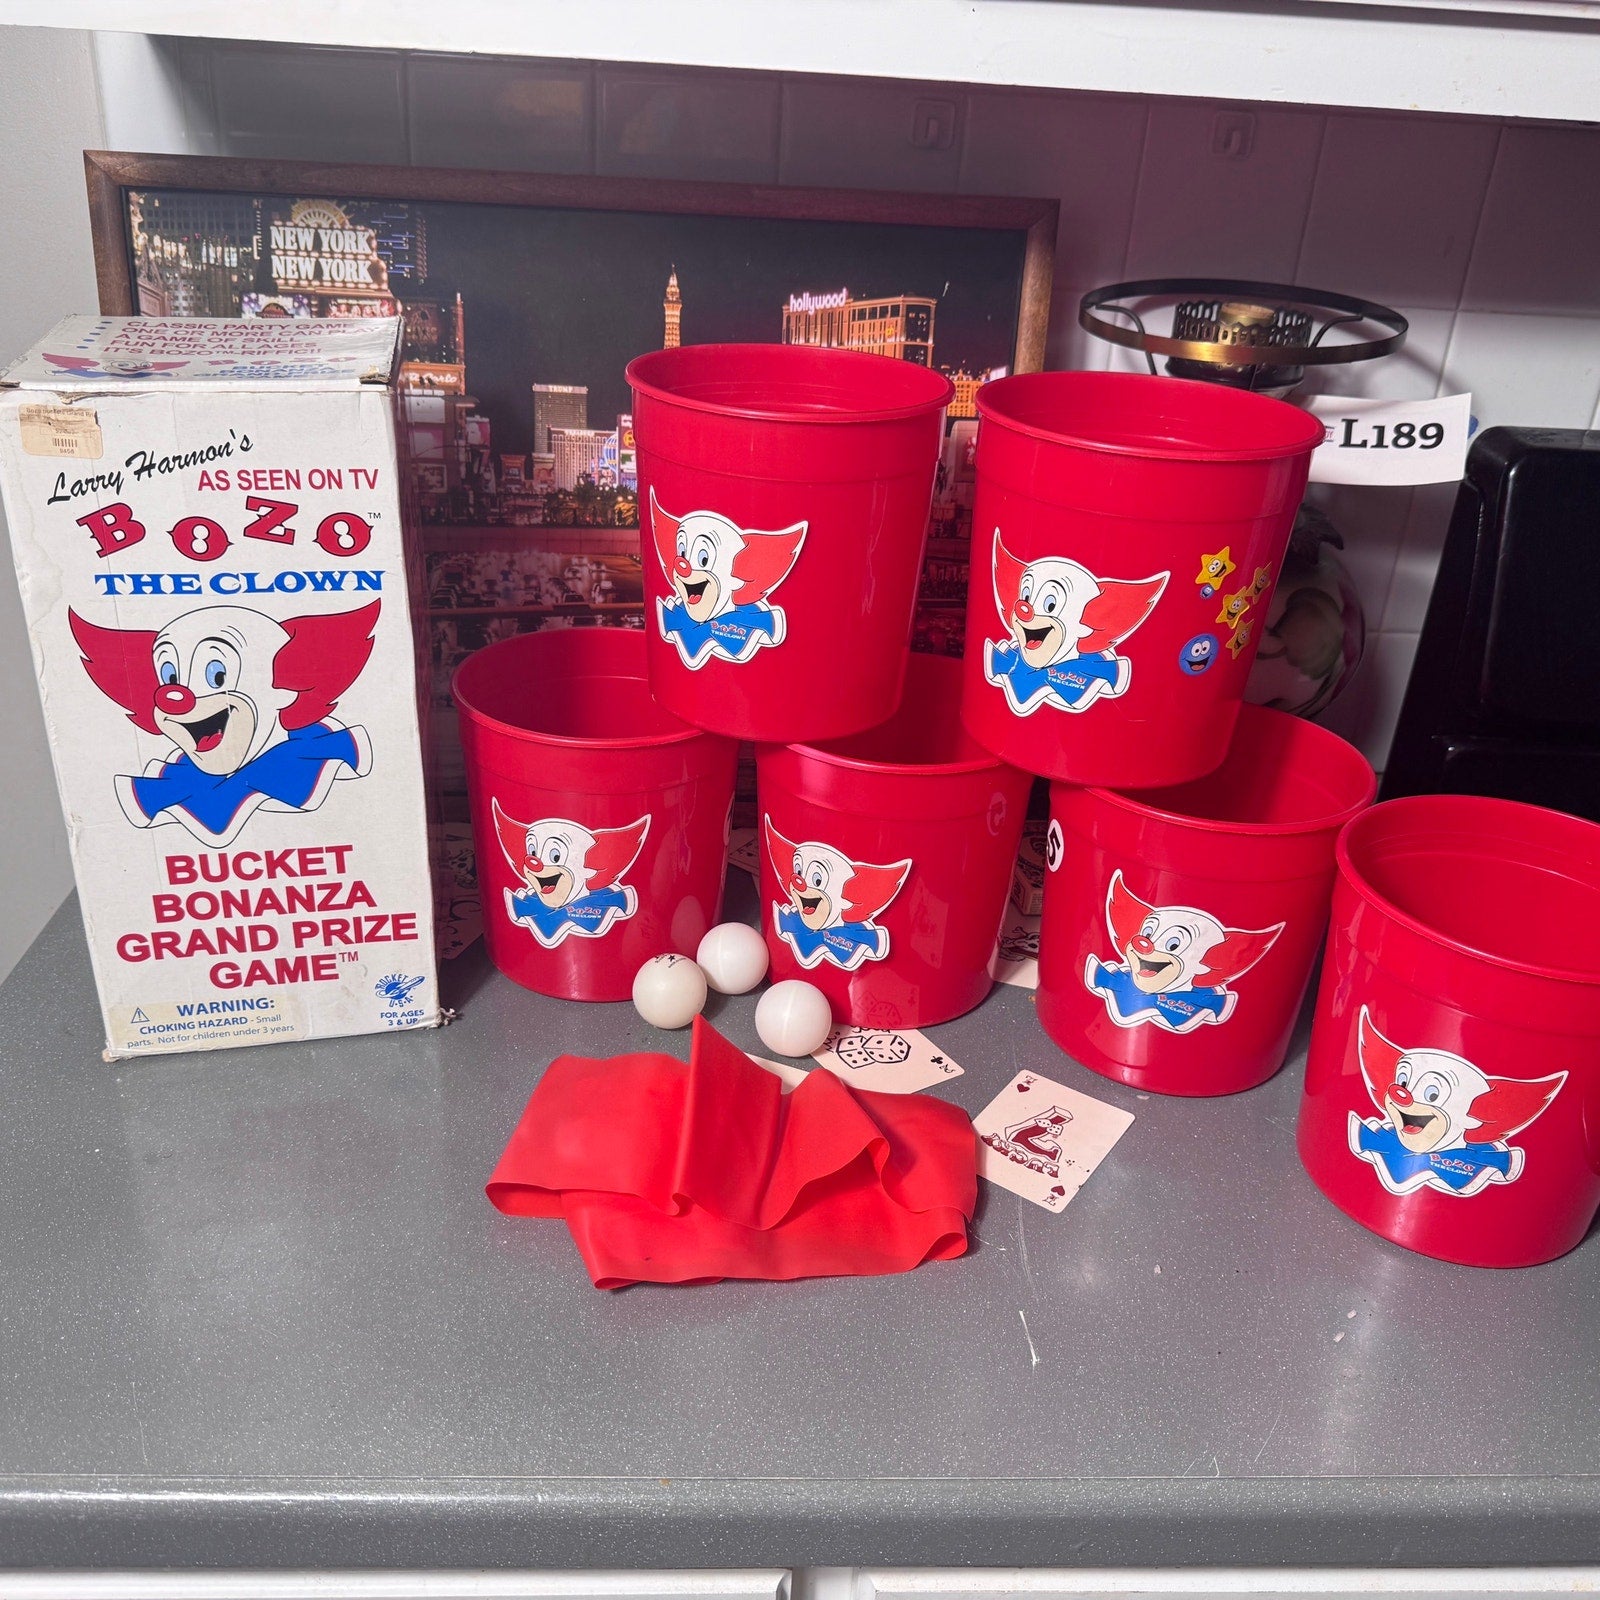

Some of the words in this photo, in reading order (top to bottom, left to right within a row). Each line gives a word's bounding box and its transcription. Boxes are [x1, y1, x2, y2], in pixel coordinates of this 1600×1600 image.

[270, 226, 315, 251] NEW
[318, 228, 372, 254] YORK
[271, 255, 316, 280] NEW
[319, 257, 373, 283] YORK
[790, 286, 848, 315] hollywood
[121, 327, 169, 335] ONE
[127, 321, 218, 330] CLASSIC
[223, 323, 291, 331] PARTY
[103, 346, 143, 354] IT'S
[110, 339, 156, 347] FUN
[1339, 418, 1444, 449] L189
[47, 471, 124, 505] Larry
[125, 429, 253, 482] Harmon's
[198, 469, 231, 491] AS
[237, 469, 301, 491] SEEN
[308, 468, 343, 490] ON
[348, 469, 379, 490] TV
[94, 573, 203, 595] THE
[209, 570, 386, 594] CLOWN
[710, 620, 747, 636] BOZO
[1047, 668, 1087, 685] BOZO
[1048, 827, 1061, 866] 5
[165, 845, 353, 886] BUCKET
[152, 880, 377, 924] BONANZA
[116, 923, 280, 963] GRAND
[292, 912, 418, 949] PRIZE
[375, 973, 408, 990] ROCKET
[176, 997, 276, 1017] WARNING:
[380, 1011, 399, 1019] FOR
[400, 1009, 425, 1018] AGES
[139, 1021, 196, 1035] CHOKING
[198, 1016, 248, 1029] HAZARD
[256, 1014, 282, 1024] Small
[406, 1017, 418, 1025] UP
[127, 1039, 154, 1049] parts.
[157, 1036, 176, 1044] Not
[177, 1034, 191, 1042] for
[192, 1030, 231, 1041] children
[233, 1028, 260, 1037] under
[262, 1026, 269, 1034] 3
[270, 1025, 295, 1036] years
[1429, 1153, 1475, 1172] BOZO
